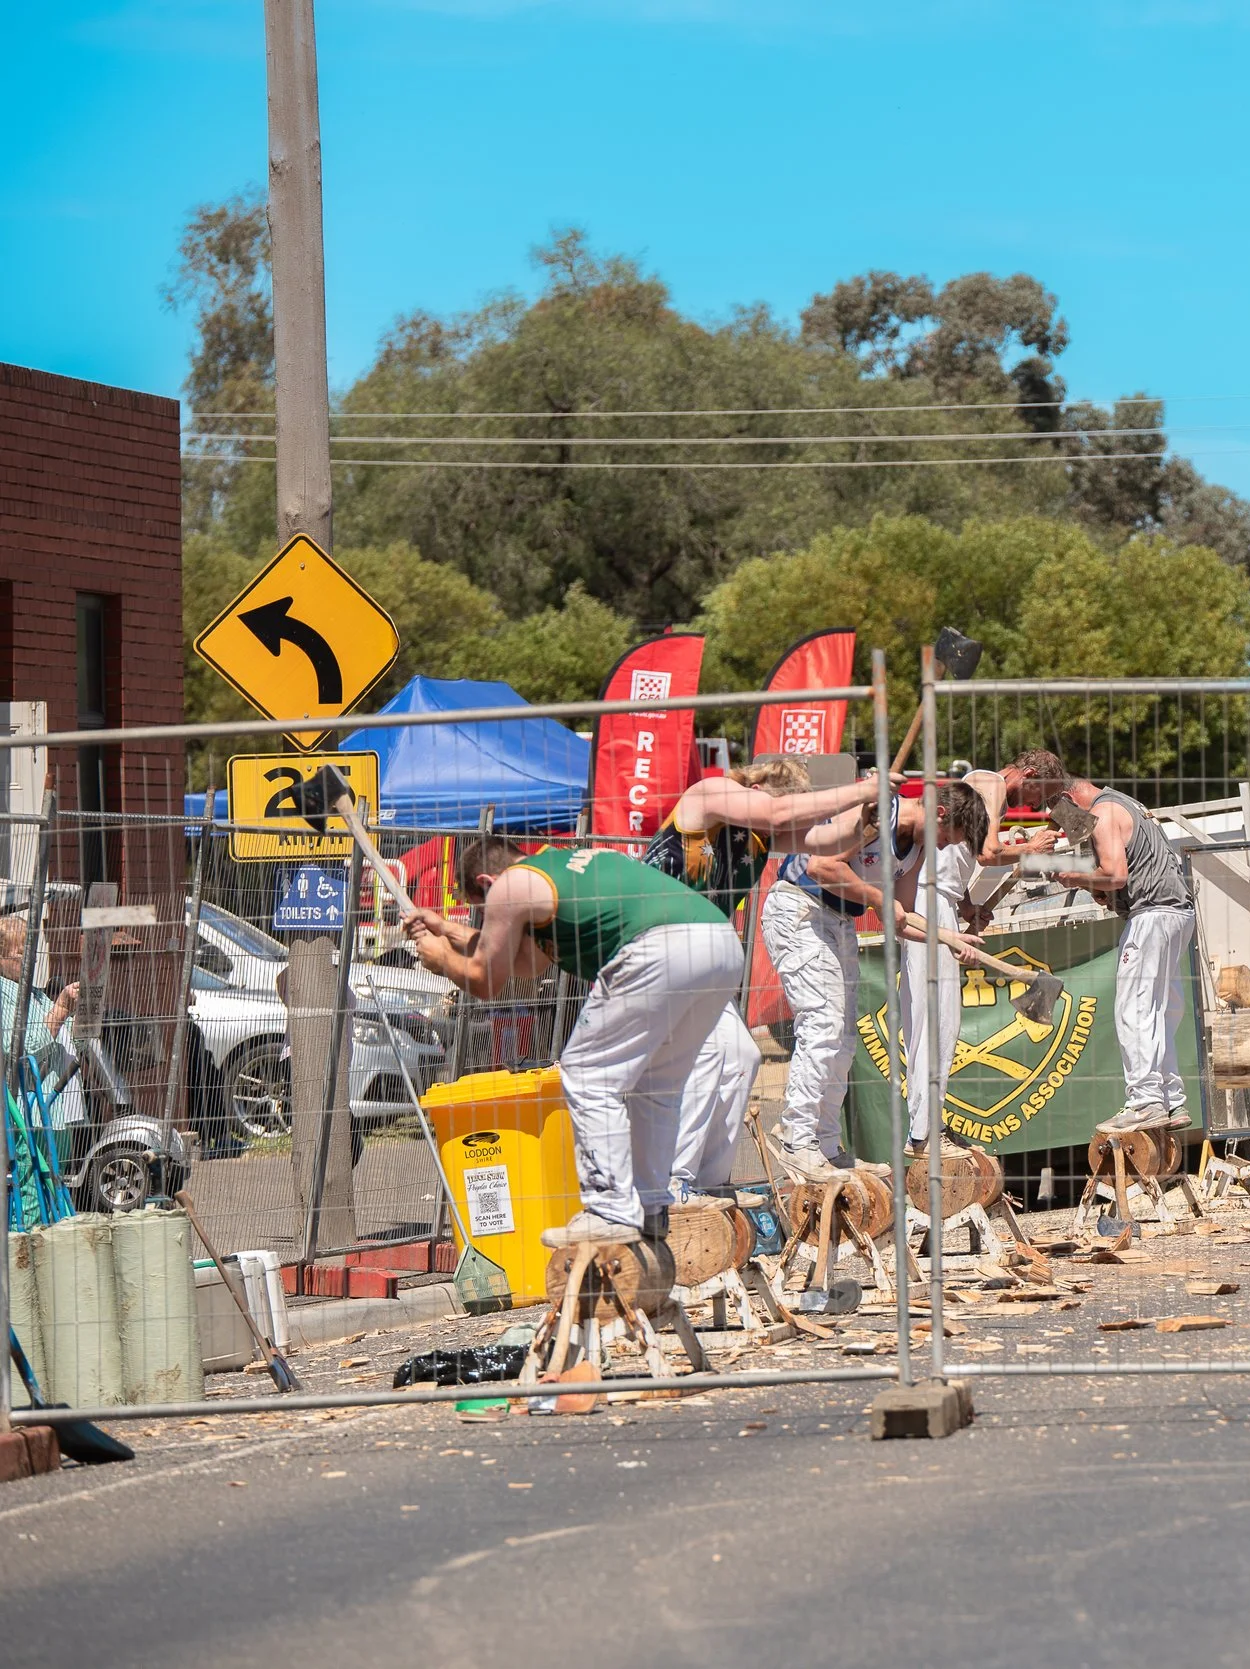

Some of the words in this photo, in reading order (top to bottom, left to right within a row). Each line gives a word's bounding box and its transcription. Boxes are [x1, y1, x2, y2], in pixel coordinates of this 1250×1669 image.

[784, 738, 818, 753] CFA
[280, 907, 322, 920] TOILETS
[941, 1108, 1022, 1144] XEMENS
[1020, 996, 1098, 1122] ASSOCIATION
[464, 1146, 503, 1160] LODDON
[475, 1214, 491, 1222] SCAN
[488, 1219, 504, 1227] VOTE
